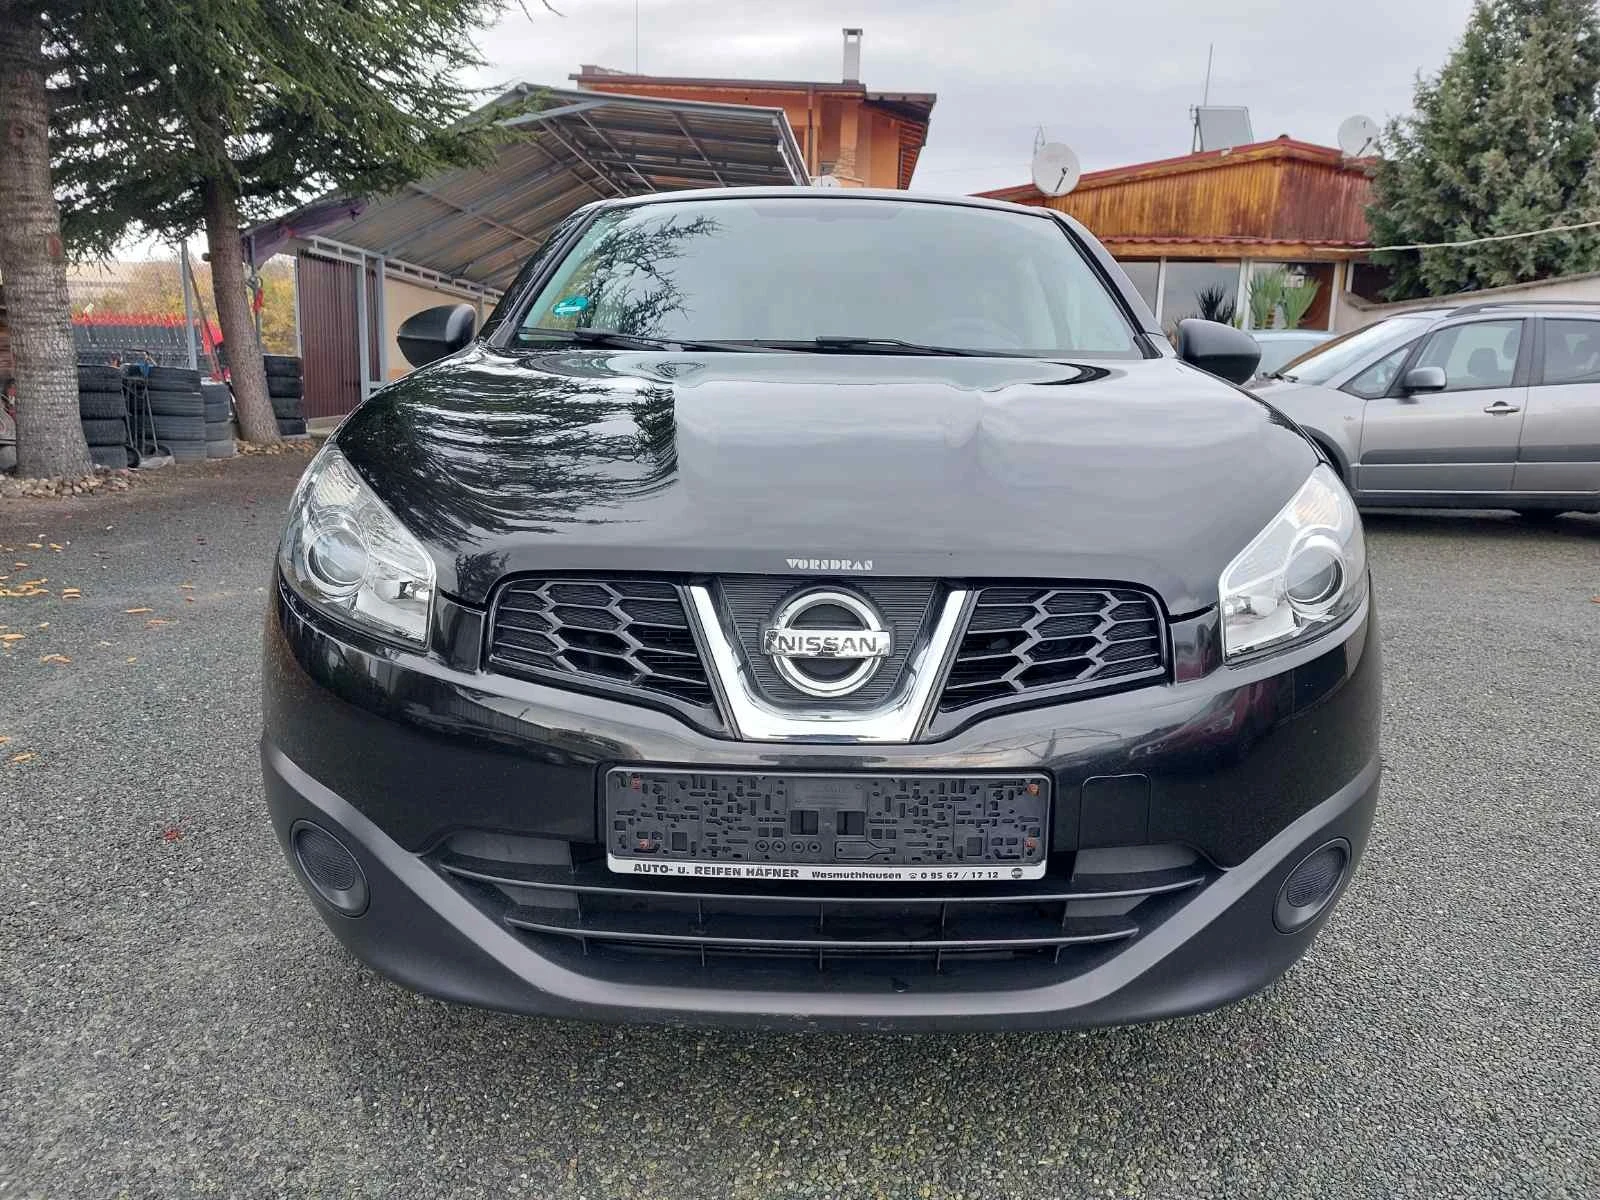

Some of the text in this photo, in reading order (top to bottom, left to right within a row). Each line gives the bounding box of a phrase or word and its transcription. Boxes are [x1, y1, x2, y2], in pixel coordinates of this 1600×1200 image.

[778, 635, 877, 653] NISSAN
[633, 863, 673, 874] AUTO-
[694, 866, 742, 877] REIFEN
[930, 871, 943, 879] 95
[946, 871, 959, 879] 67
[971, 871, 983, 879] 17
[987, 871, 999, 879] 12
